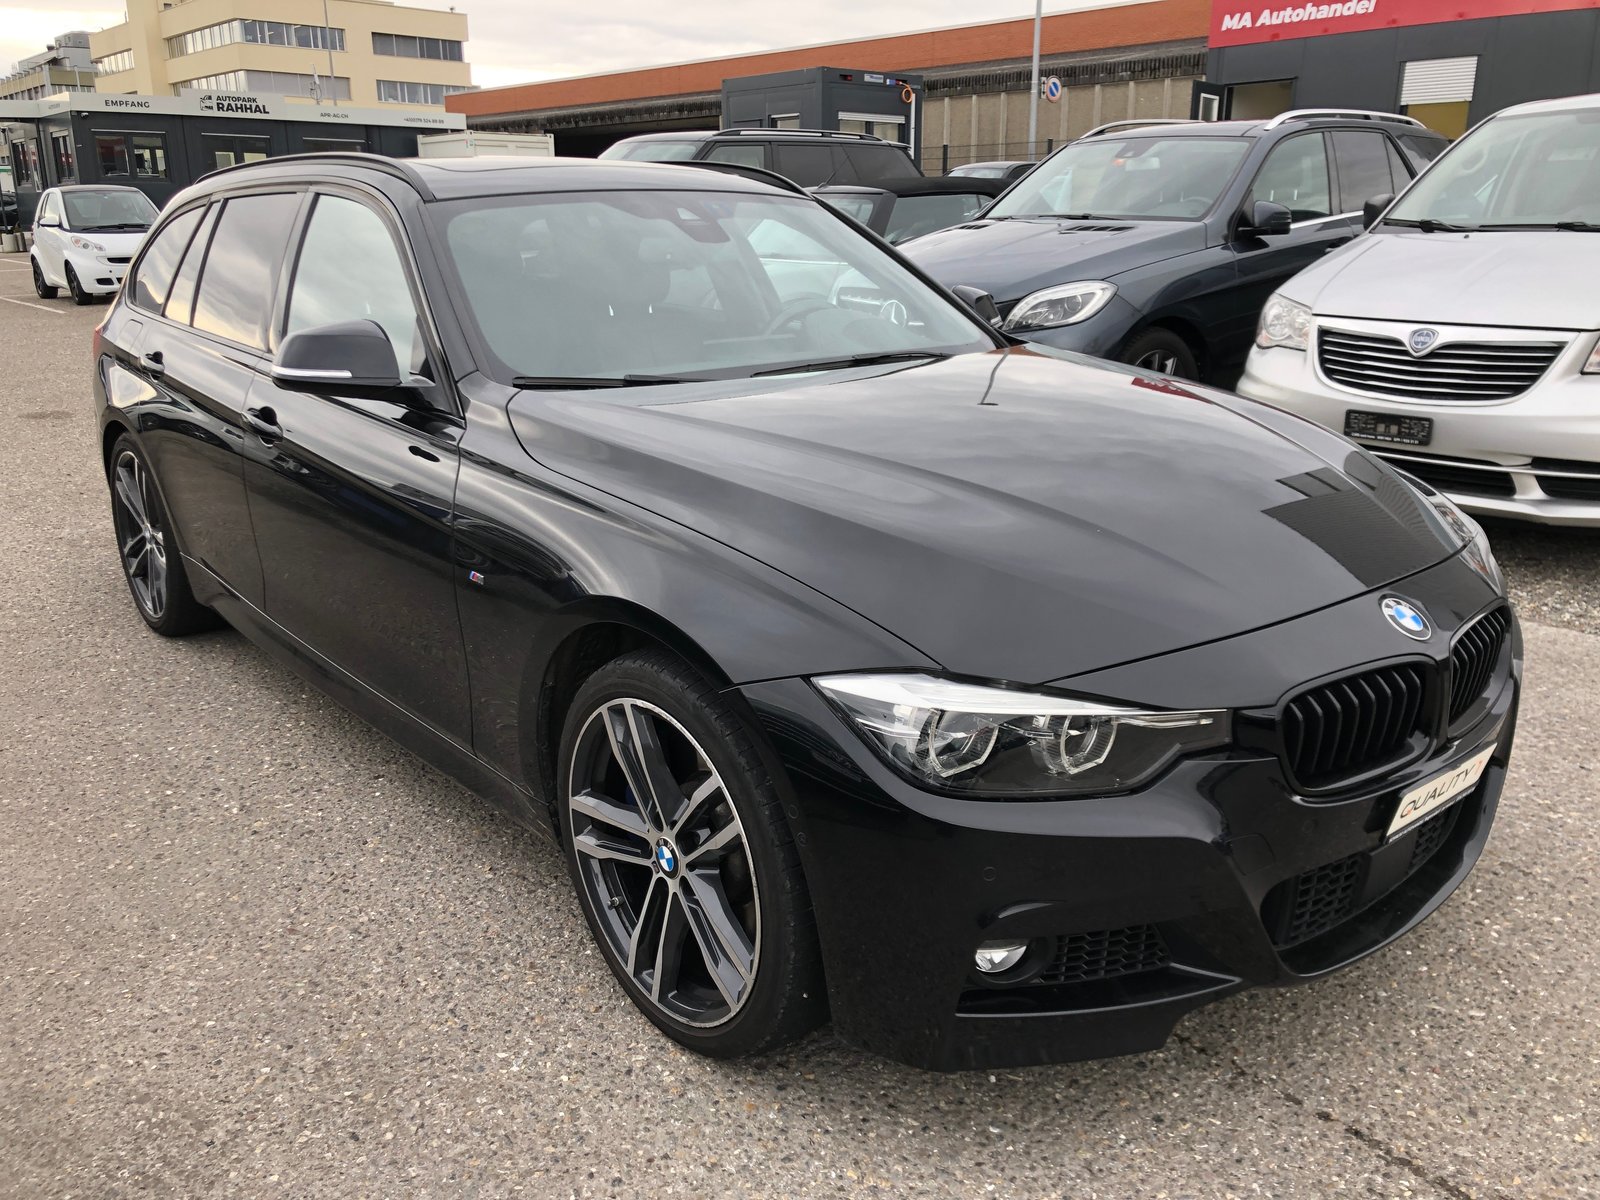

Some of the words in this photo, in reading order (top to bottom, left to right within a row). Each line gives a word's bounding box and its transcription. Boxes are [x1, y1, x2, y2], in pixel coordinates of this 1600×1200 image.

[1221, 12, 1252, 31] MA
[1255, 0, 1376, 27] Autohandel
[104, 99, 150, 108] EMPFANG
[216, 95, 258, 103] AUTOPARK
[216, 102, 270, 115] RAHHAL
